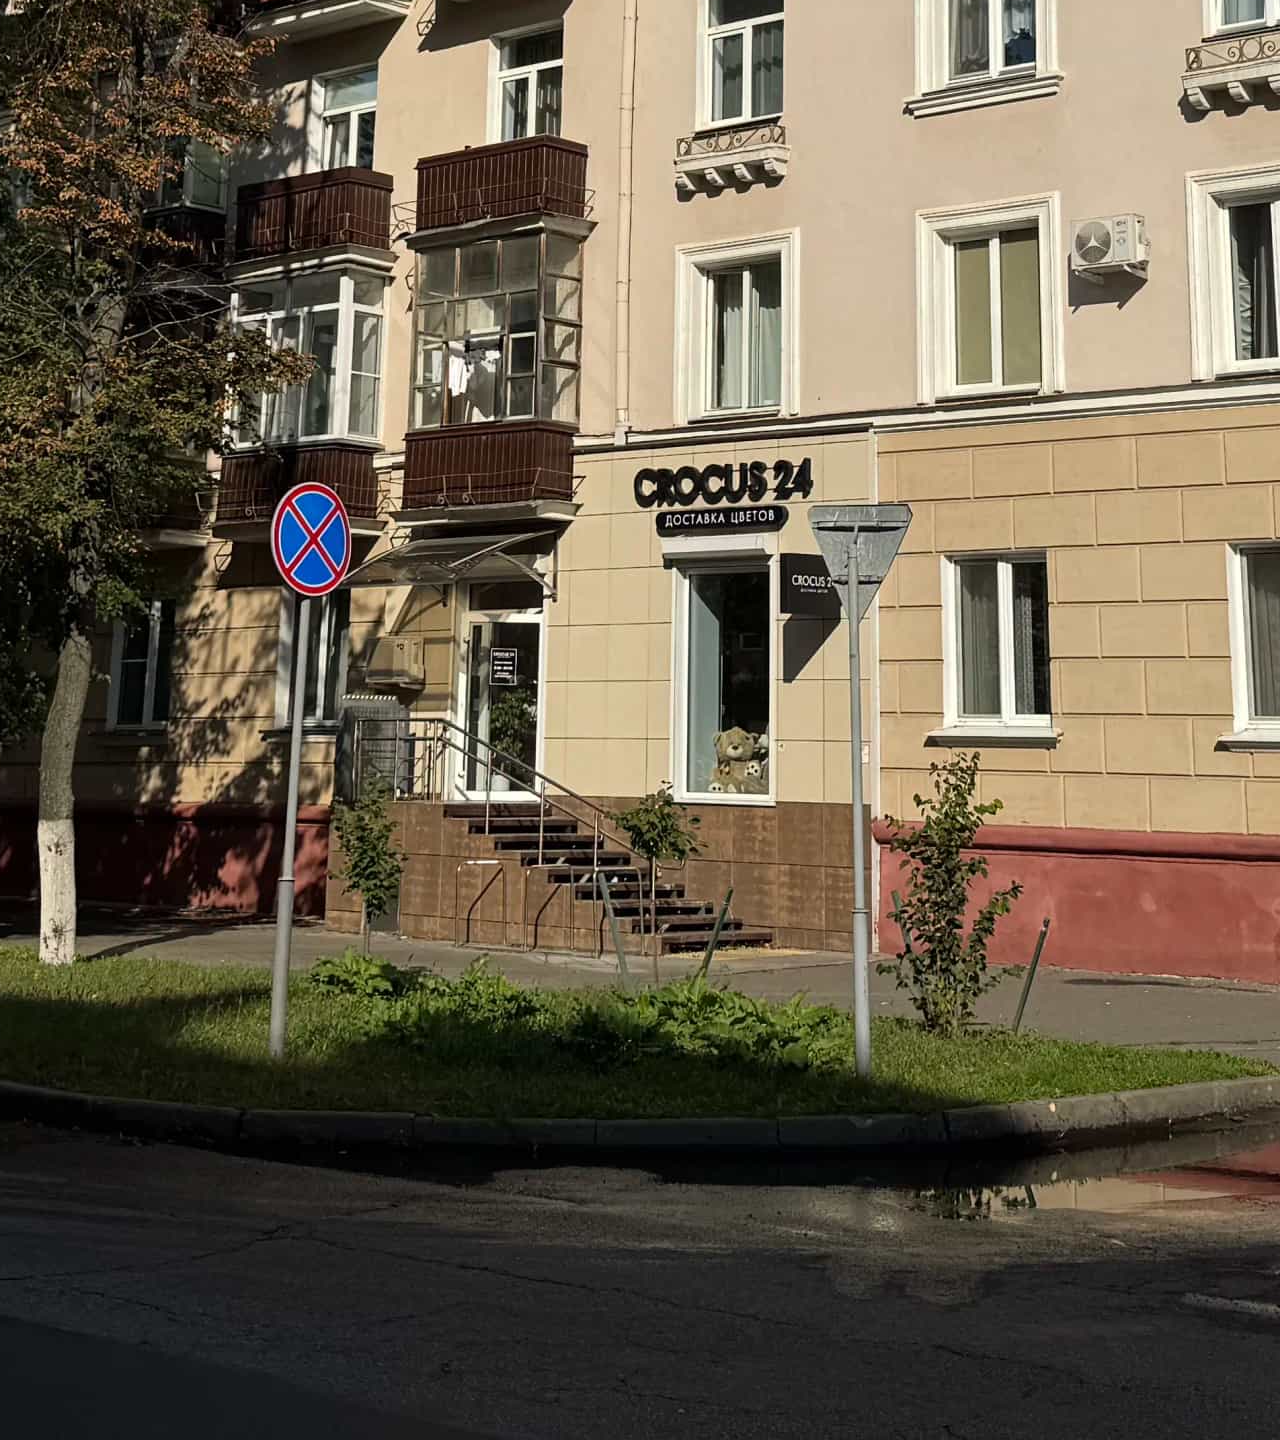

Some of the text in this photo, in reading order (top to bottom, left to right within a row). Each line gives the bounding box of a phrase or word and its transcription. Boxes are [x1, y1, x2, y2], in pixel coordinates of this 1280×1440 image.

[634, 457, 814, 508] CROCUS 24
[665, 509, 776, 528] ДОСТАВКА ЦВЕТОВ
[791, 574, 826, 588] CROCUS
